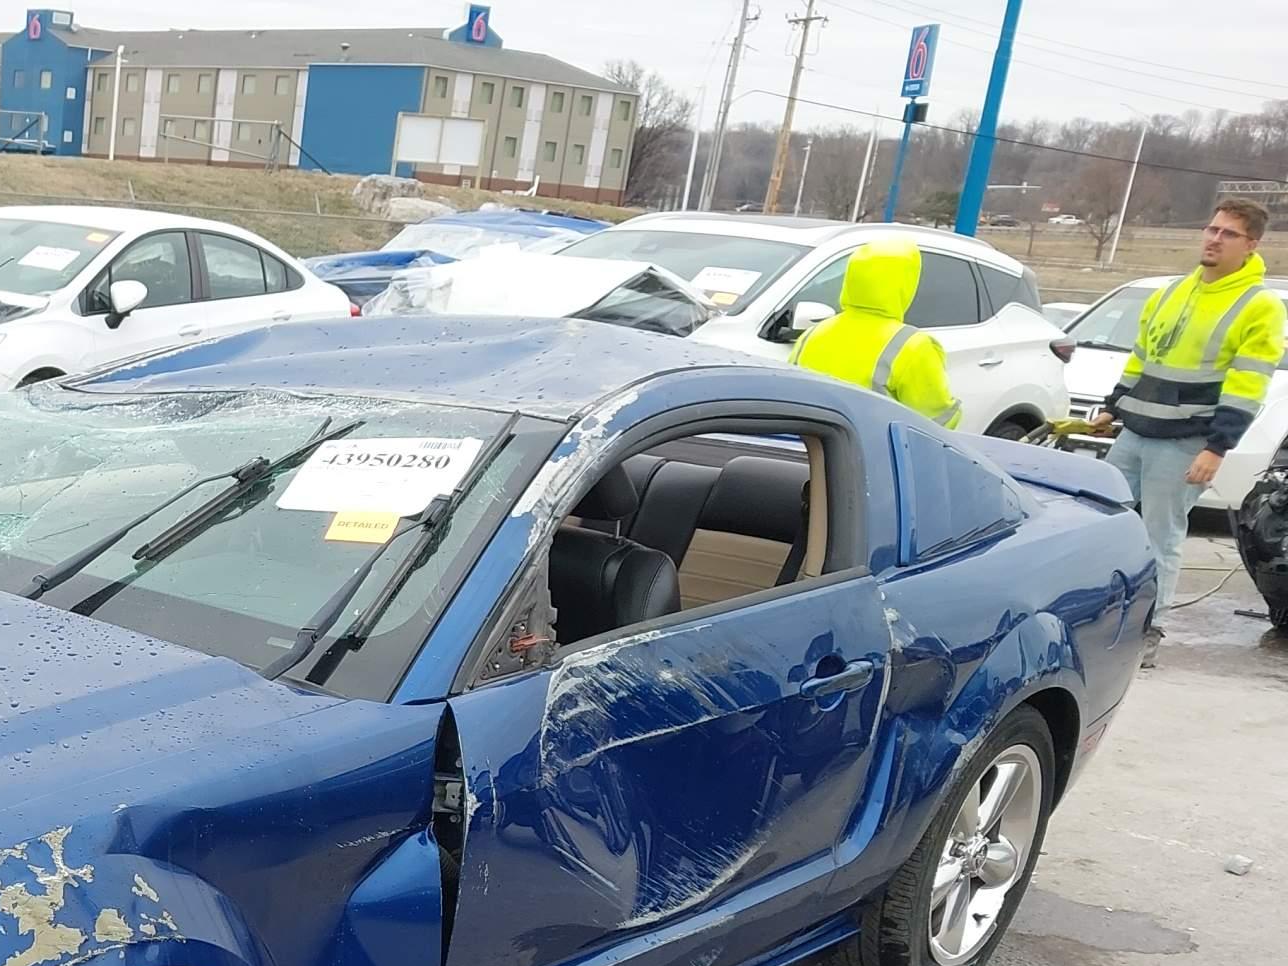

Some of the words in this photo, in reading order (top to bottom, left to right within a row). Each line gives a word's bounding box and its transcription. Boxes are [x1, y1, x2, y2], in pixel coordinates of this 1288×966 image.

[29, 14, 40, 39] 6
[472, 12, 486, 41] 6
[910, 27, 929, 79] 6
[322, 453, 451, 469] 43950280
[336, 520, 389, 529] DETAILED
